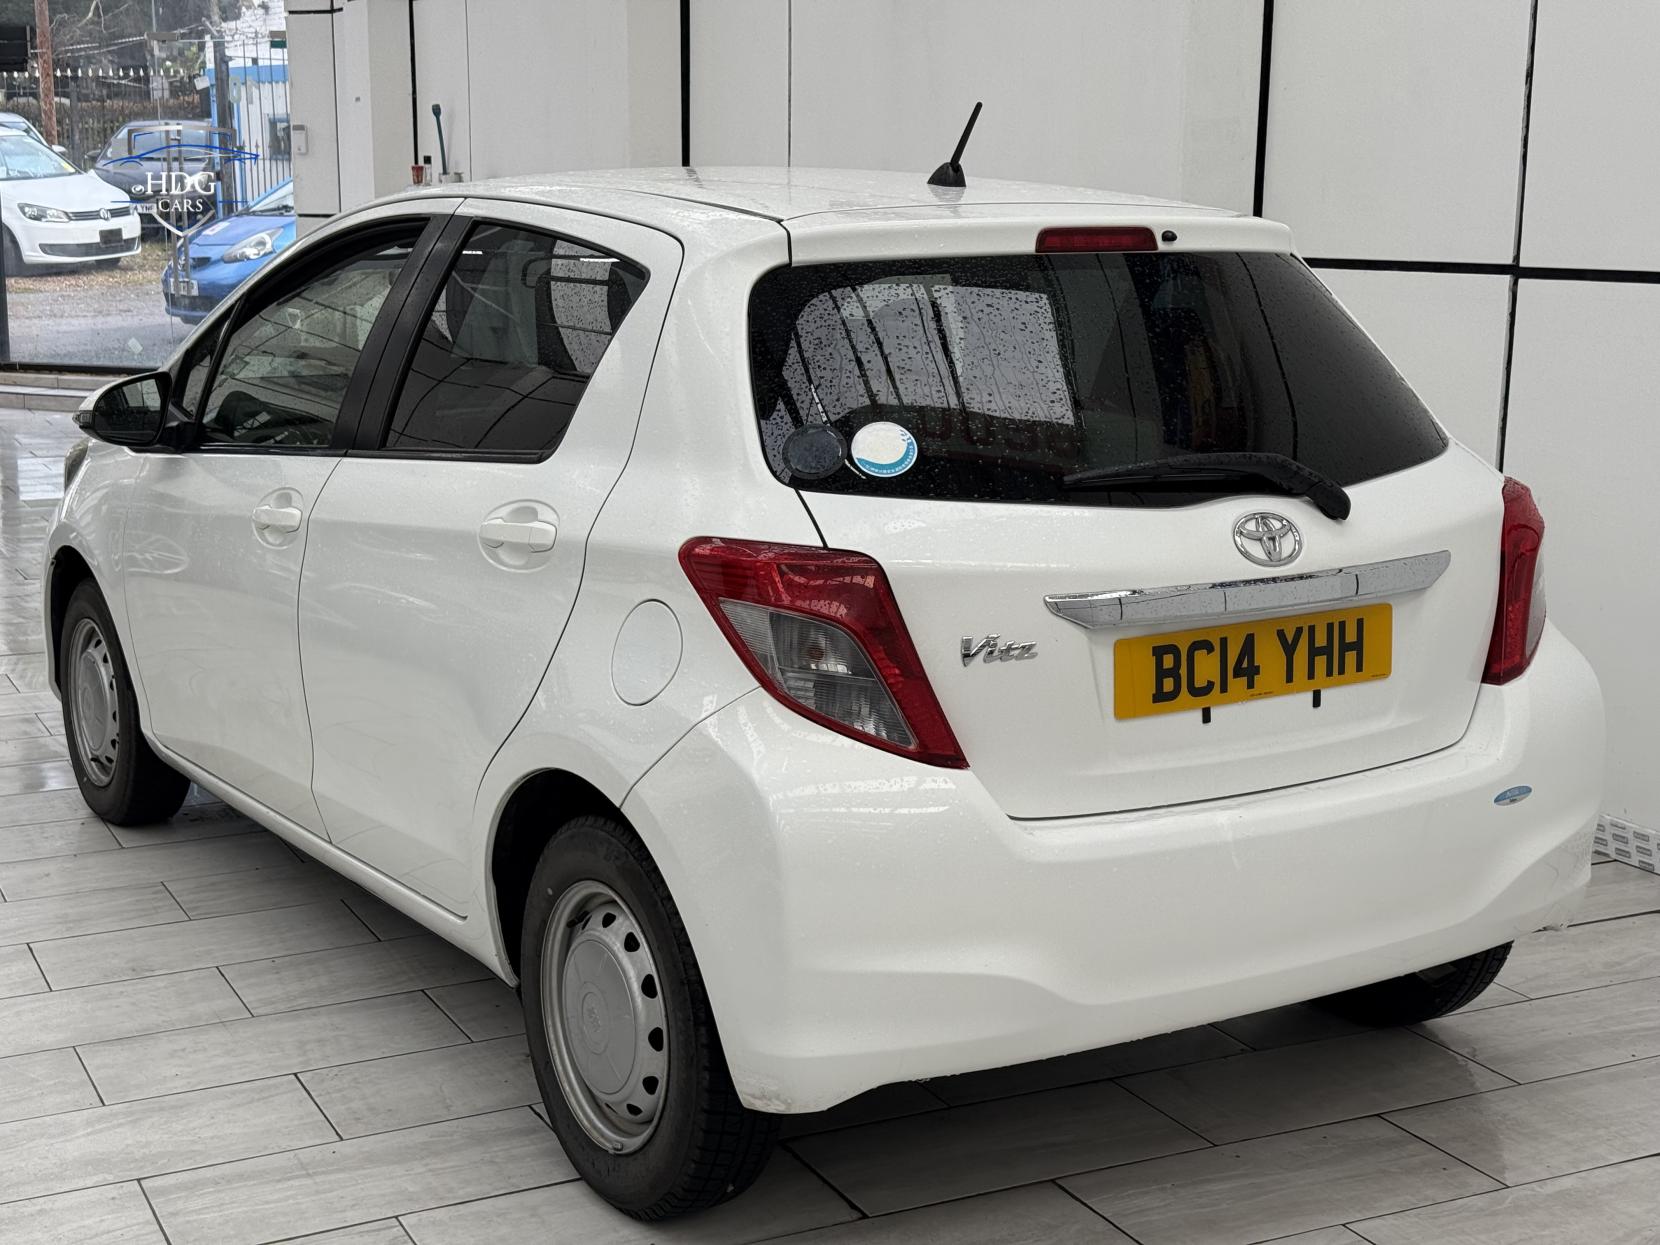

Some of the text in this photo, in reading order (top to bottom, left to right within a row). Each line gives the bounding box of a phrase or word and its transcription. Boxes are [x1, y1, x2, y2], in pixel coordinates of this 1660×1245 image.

[145, 171, 216, 195] HDG
[158, 199, 203, 212] CARS
[961, 633, 1038, 667] Vitz
[1152, 618, 1364, 703] BC14 YHH
